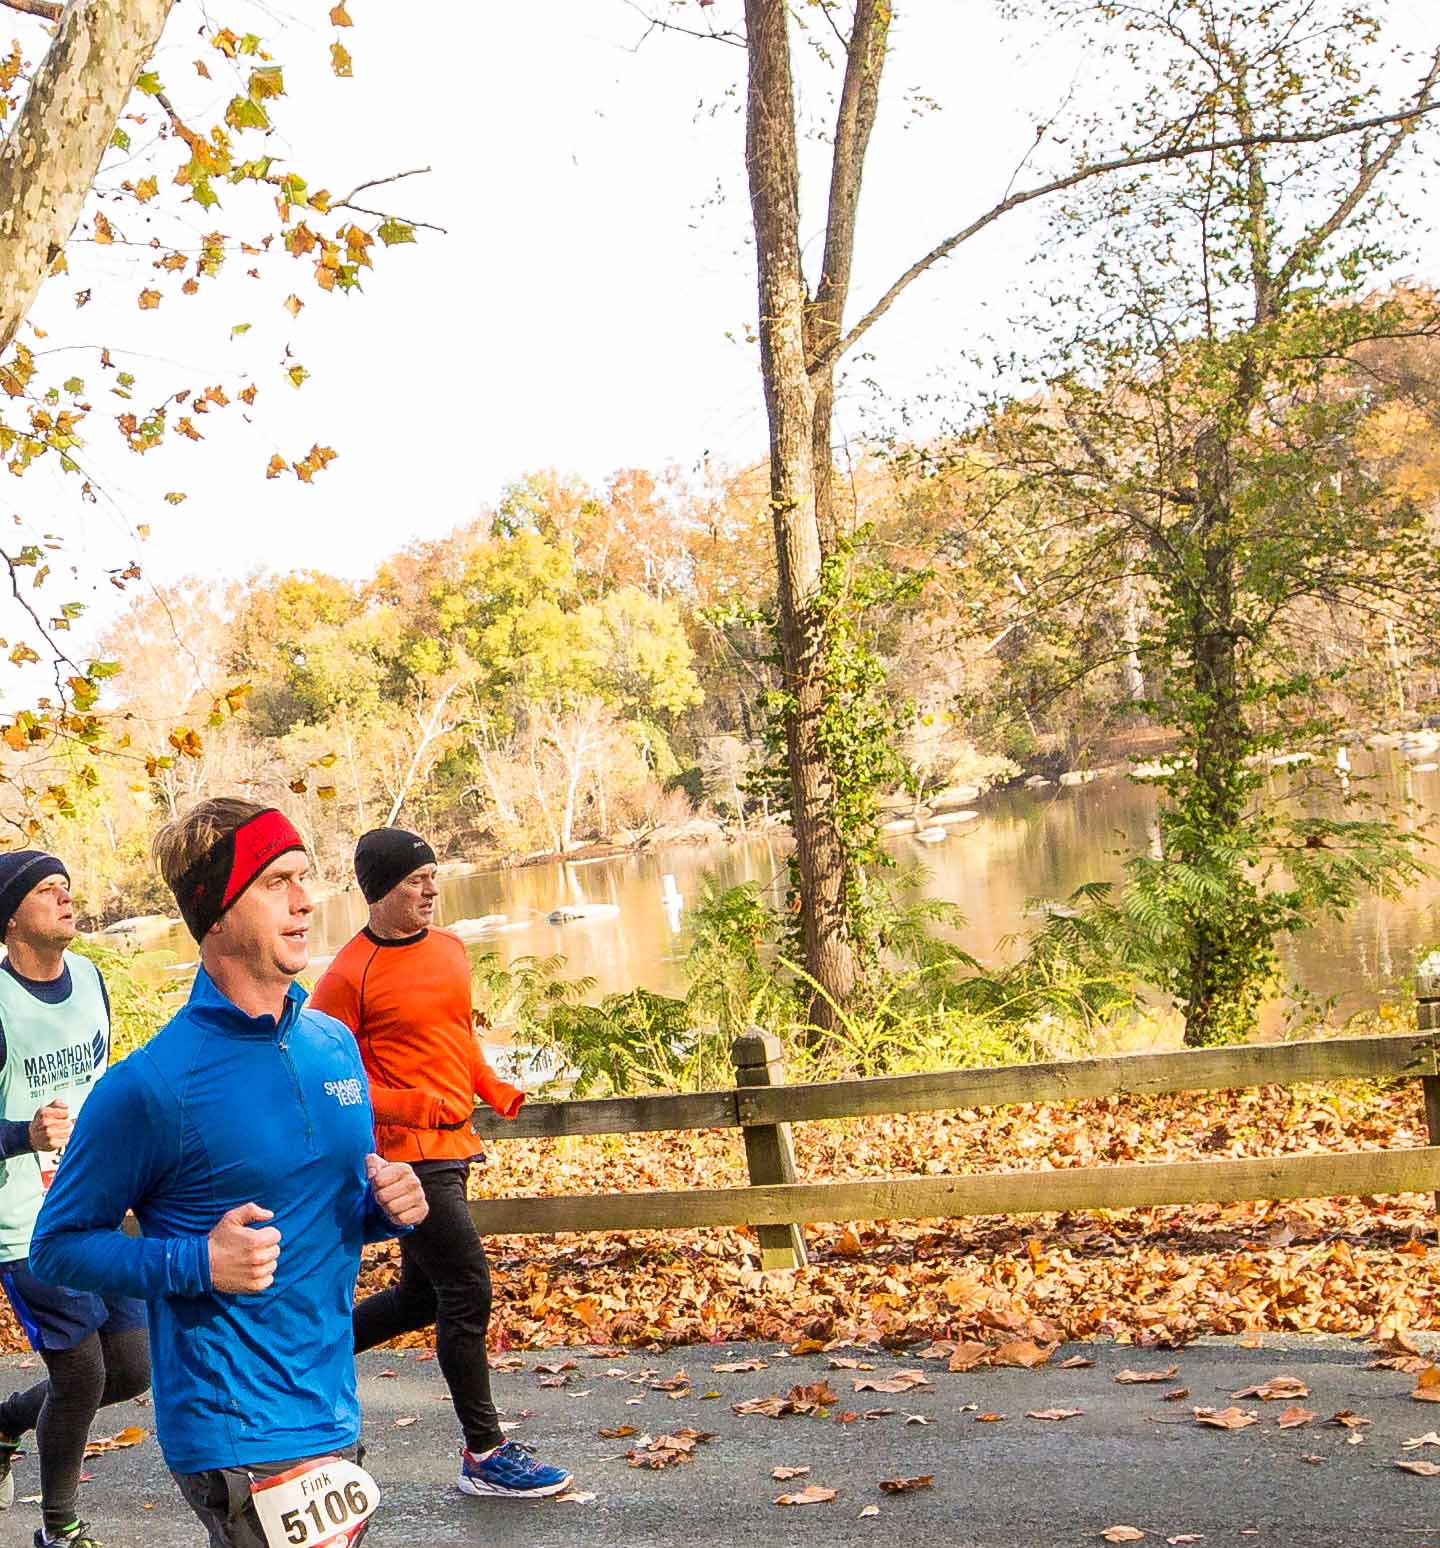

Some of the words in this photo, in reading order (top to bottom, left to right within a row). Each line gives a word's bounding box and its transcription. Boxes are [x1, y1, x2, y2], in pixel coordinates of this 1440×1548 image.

[23, 1041, 92, 1076] MARATHON
[26, 1064, 70, 1088] TRAINING
[70, 1059, 93, 1076] TEAM
[336, 1089, 363, 1107] TECH
[300, 1472, 333, 1497] Fink
[280, 1480, 369, 1545] 5106
